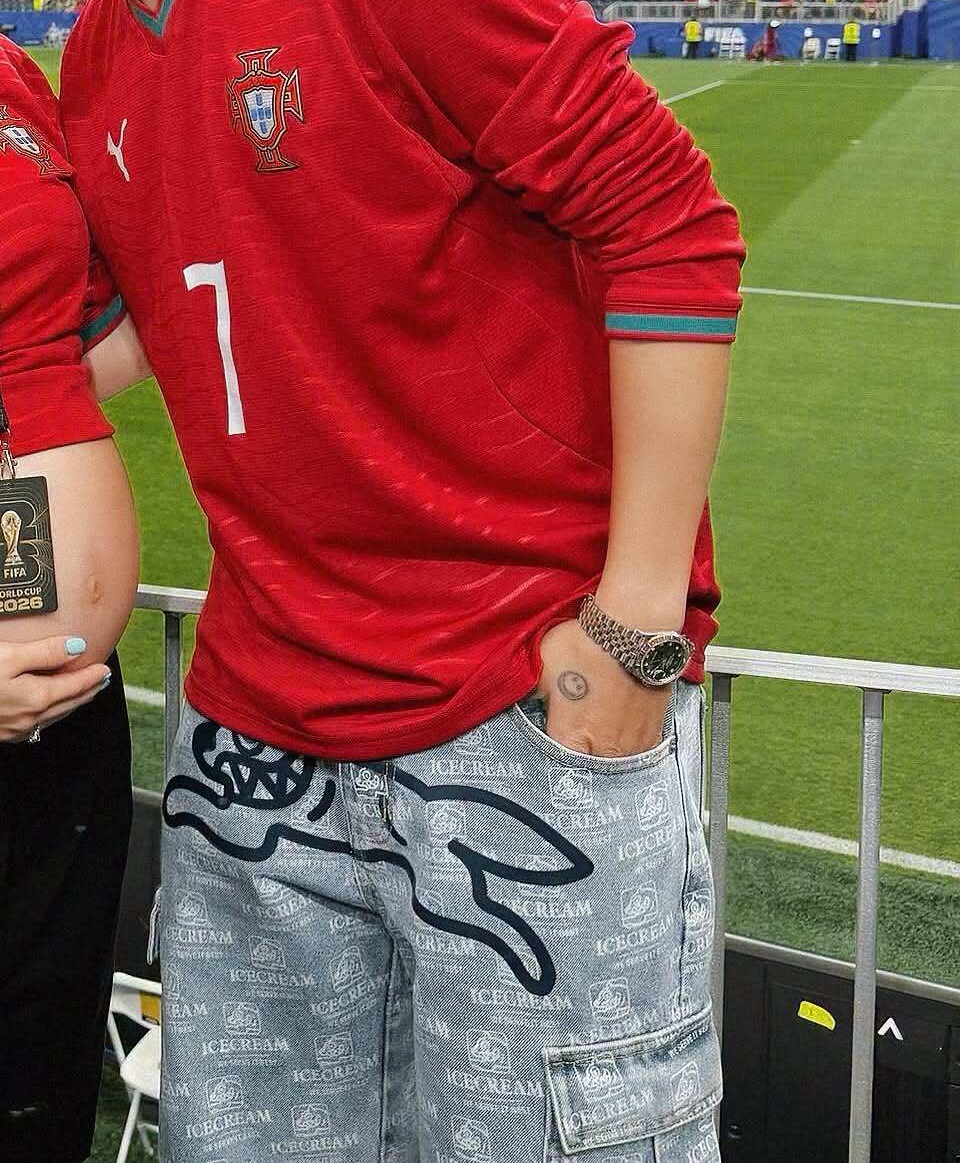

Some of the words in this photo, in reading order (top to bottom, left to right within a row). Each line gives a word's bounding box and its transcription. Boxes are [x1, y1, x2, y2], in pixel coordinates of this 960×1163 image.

[183, 259, 246, 436] 7
[3, 567, 27, 579] FIFA
[23, 587, 42, 596] CUP
[431, 759, 526, 779] ICECREAM
[592, 911, 674, 957] ICECREAM
[230, 968, 316, 988] ICECREAM
[470, 988, 573, 1011] ICECREAM
[202, 1038, 290, 1056] ICECREAM
[293, 1055, 379, 1083] ICECREAM
[445, 1068, 545, 1098] ICECREAM
[186, 1109, 273, 1139] ICECREAM
[270, 1131, 359, 1154] ICECREAM
